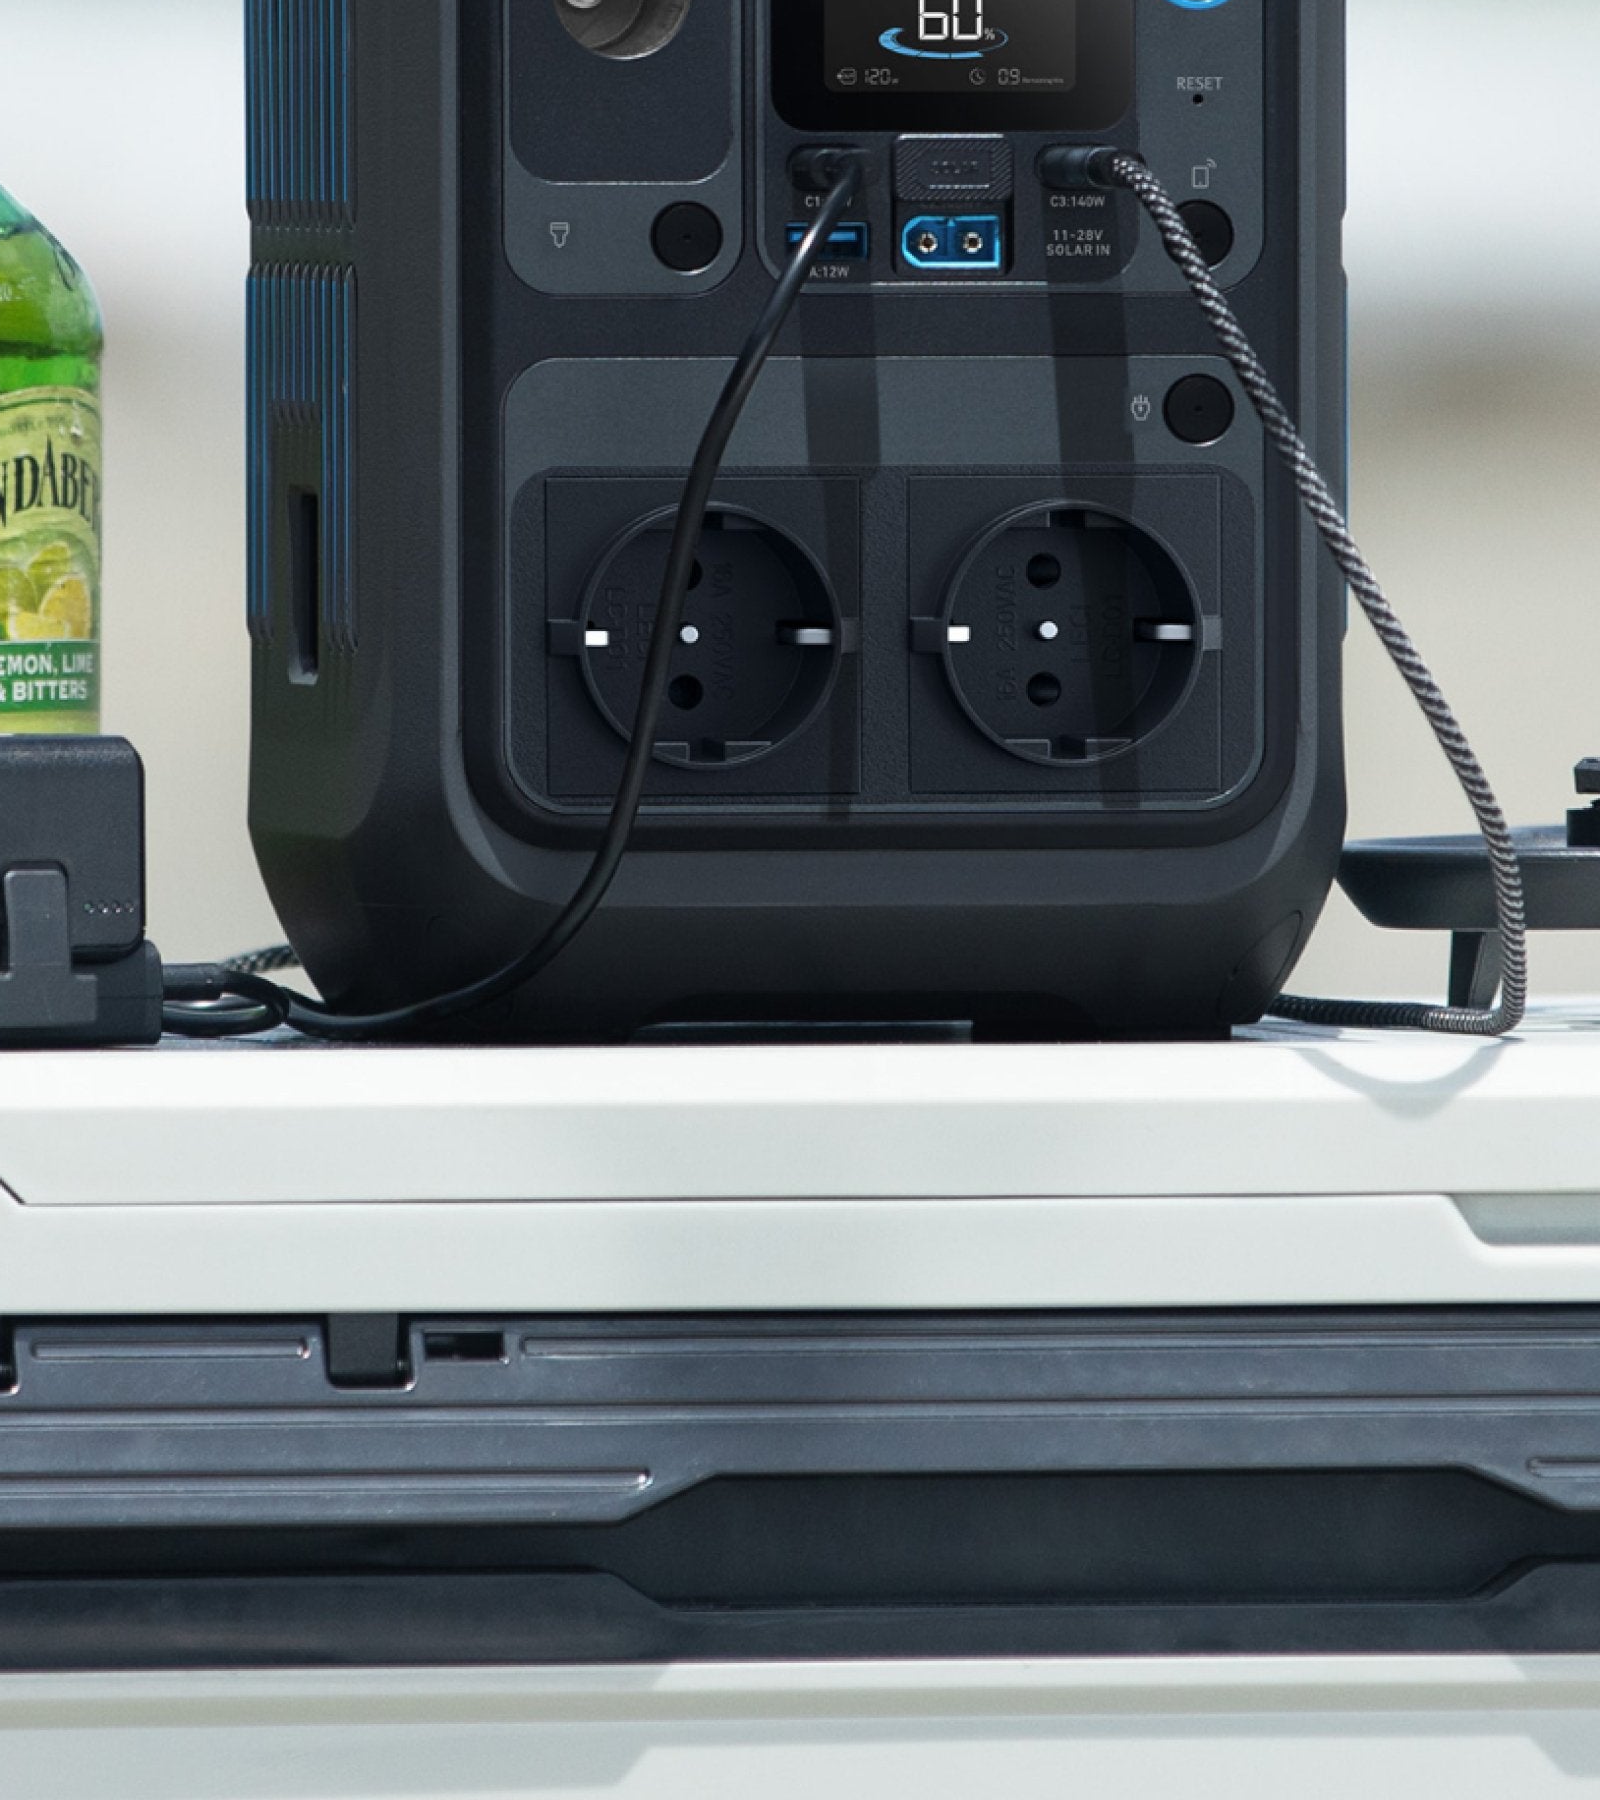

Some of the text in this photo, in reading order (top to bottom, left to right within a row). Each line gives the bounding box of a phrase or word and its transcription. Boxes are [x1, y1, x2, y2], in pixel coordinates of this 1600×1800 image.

[1176, 76, 1224, 91] RESET
[1049, 195, 1106, 208] C3:140W
[1046, 243, 1112, 257] SOLAR IN
[809, 265, 850, 278] A:12W
[62, 652, 94, 674] LIME
[12, 678, 88, 701] BITTERS
